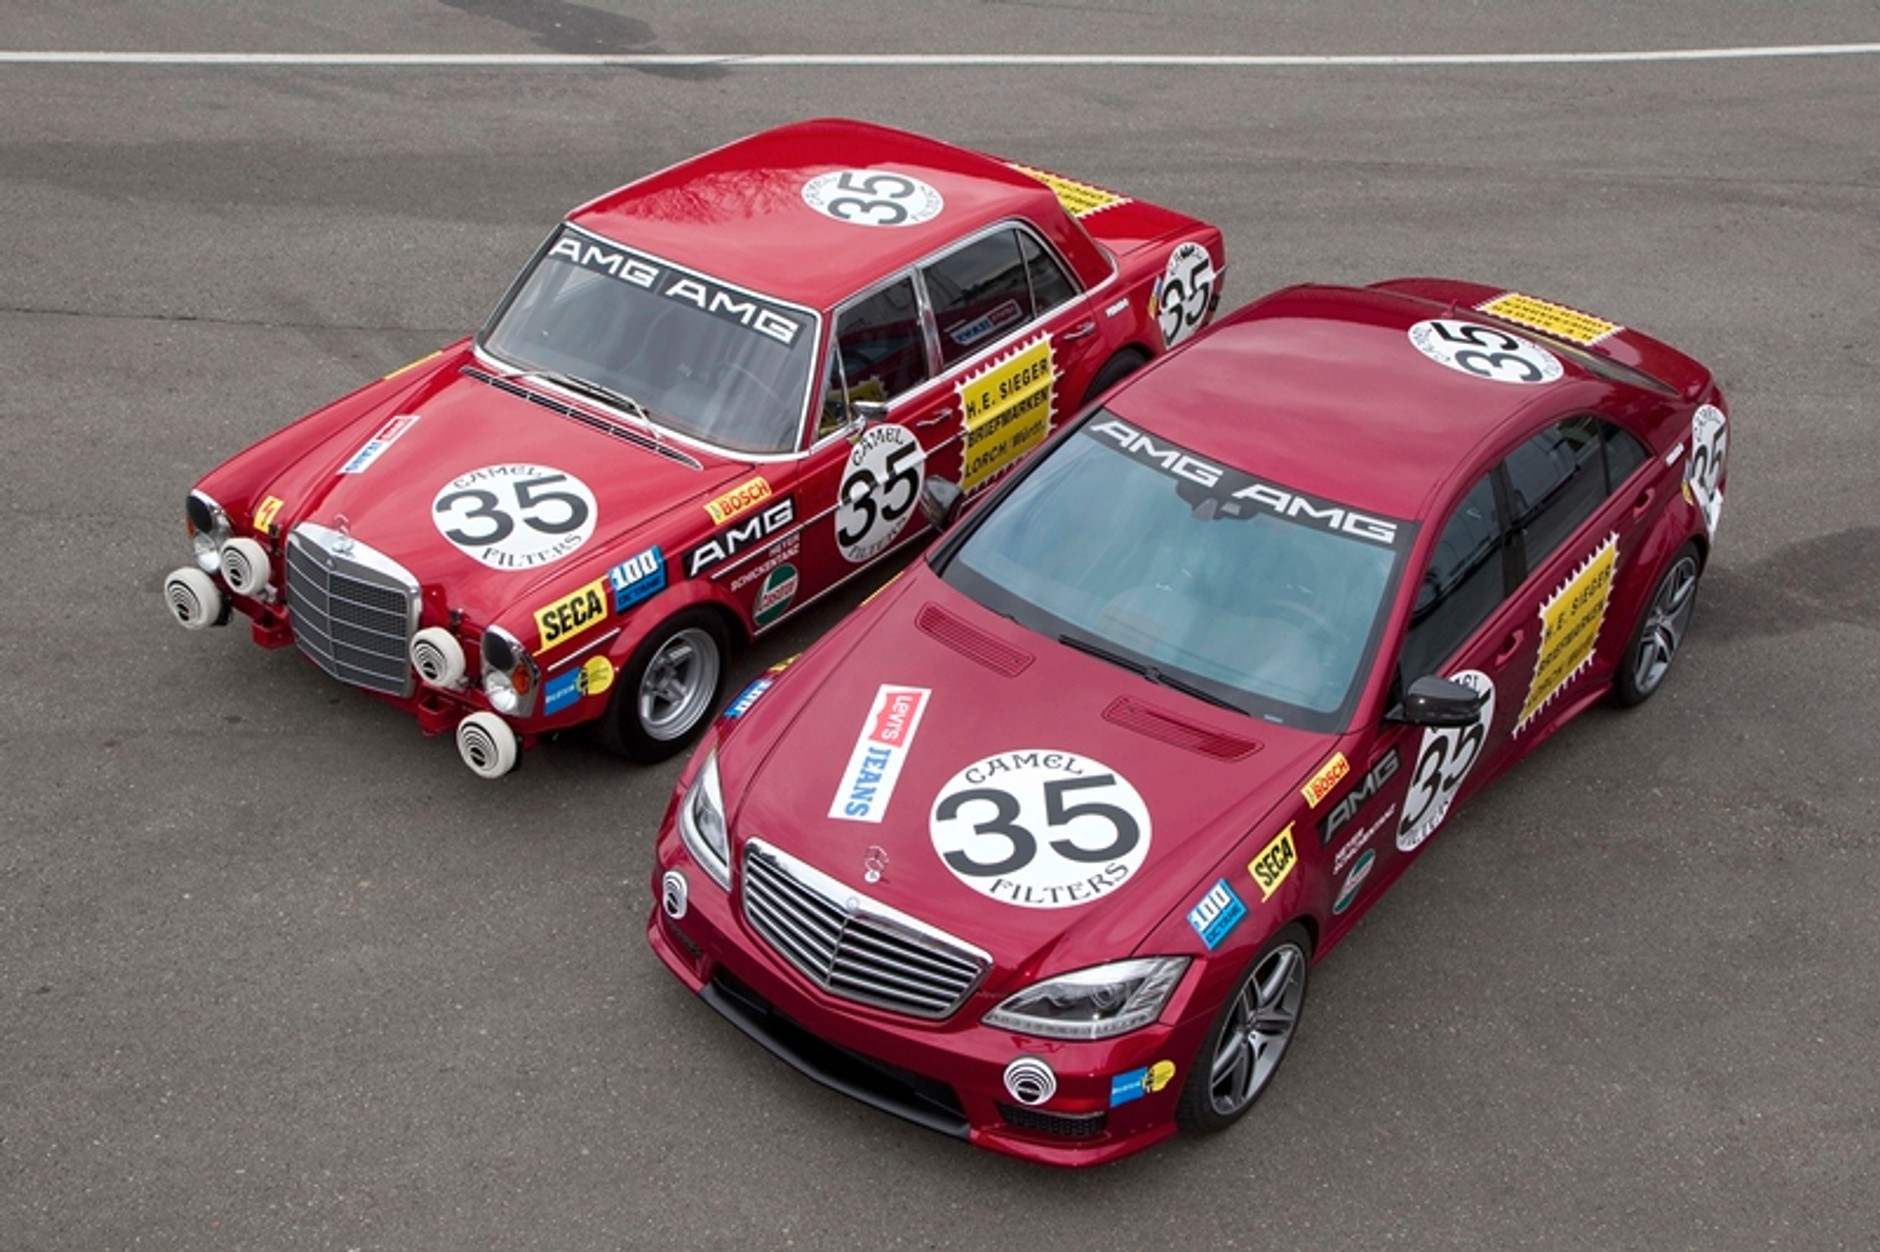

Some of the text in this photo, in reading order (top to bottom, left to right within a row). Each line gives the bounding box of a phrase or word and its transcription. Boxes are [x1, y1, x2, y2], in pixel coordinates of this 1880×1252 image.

[827, 172, 916, 225] 35
[548, 238, 799, 344] AMG AMG
[1430, 321, 1543, 382] 35
[999, 358, 1048, 400] SIEGER
[852, 428, 904, 467] CAMEL
[453, 466, 542, 490] CAMEL
[720, 481, 771, 517] BOSCH
[838, 440, 921, 548] 35
[1089, 420, 1397, 544] AMG AMG
[435, 474, 589, 546] 35
[482, 533, 582, 567] FILTERS
[690, 499, 794, 577] AMG
[542, 589, 603, 641] SECA
[844, 747, 892, 817] JEANS
[965, 753, 1083, 785] CAMEL
[1311, 761, 1349, 800] BOSCH
[1399, 688, 1491, 836] 35
[1322, 749, 1400, 844] AMG
[935, 773, 1140, 878] 35
[989, 862, 1129, 904] FILTERS
[1254, 836, 1294, 887] SECA
